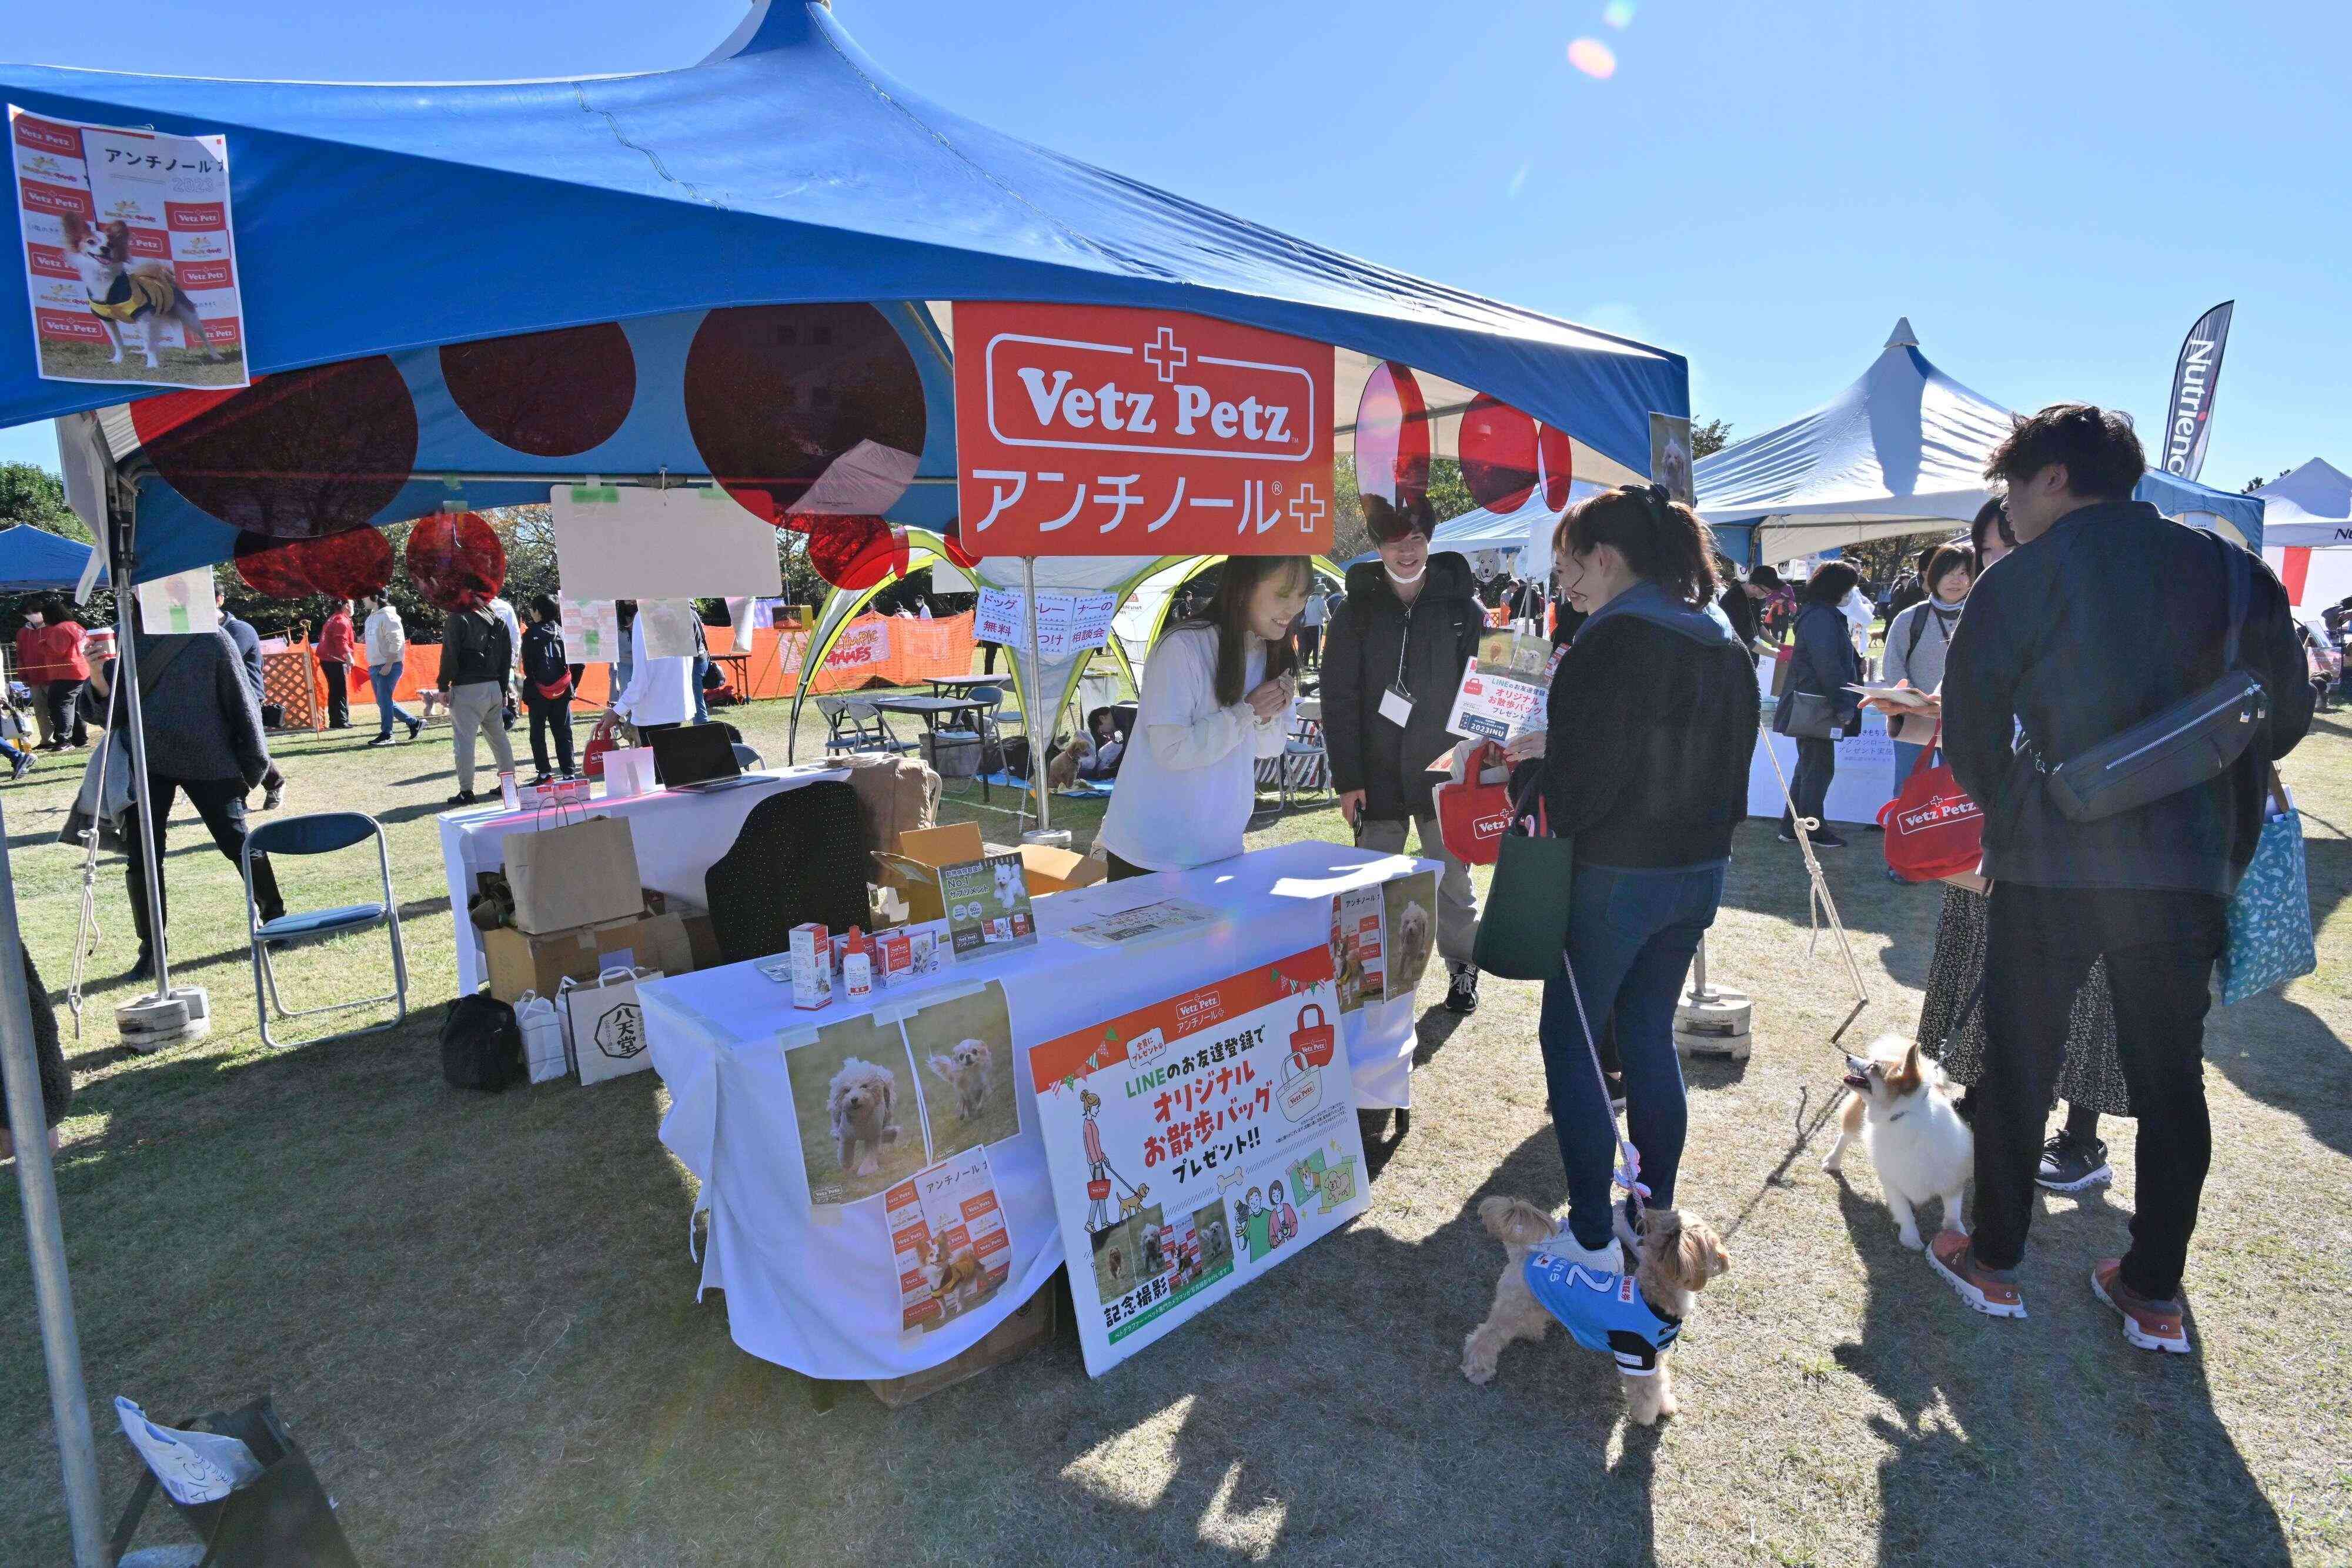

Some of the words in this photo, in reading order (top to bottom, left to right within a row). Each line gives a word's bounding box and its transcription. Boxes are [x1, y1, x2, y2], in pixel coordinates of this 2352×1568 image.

[173, 178, 214, 193] 2023
[1017, 367, 1156, 434] Vetz
[2168, 340, 2214, 476] Nutrienc
[832, 630, 878, 650] LYMPIC
[1488, 696, 1543, 716] お散歩バッグ
[1496, 688, 1539, 706] オリジナル
[1471, 723, 1504, 737] 2023INU
[1906, 811, 1939, 826] Vetz
[1941, 802, 1977, 817] Petz
[1479, 820, 1505, 833] Vetz
[947, 876, 970, 890] No.1
[1180, 1004, 1198, 1015] Vetz
[1200, 998, 1217, 1009] Petz
[613, 1008, 636, 1055] 八天堂
[1177, 1011, 1218, 1034] アンチノール
[1137, 1037, 1154, 1051] 全員に
[1125, 1024, 1265, 1098] LINEのお友達登録で
[1154, 1060, 1255, 1123] オリジナル
[1289, 1094, 1301, 1104] Vetz
[1302, 1086, 1314, 1096] Petz
[1144, 1079, 1272, 1168] お散歩バッグ
[927, 1165, 980, 1193] アンチノール
[1104, 1276, 1168, 1328] 記念撮影
